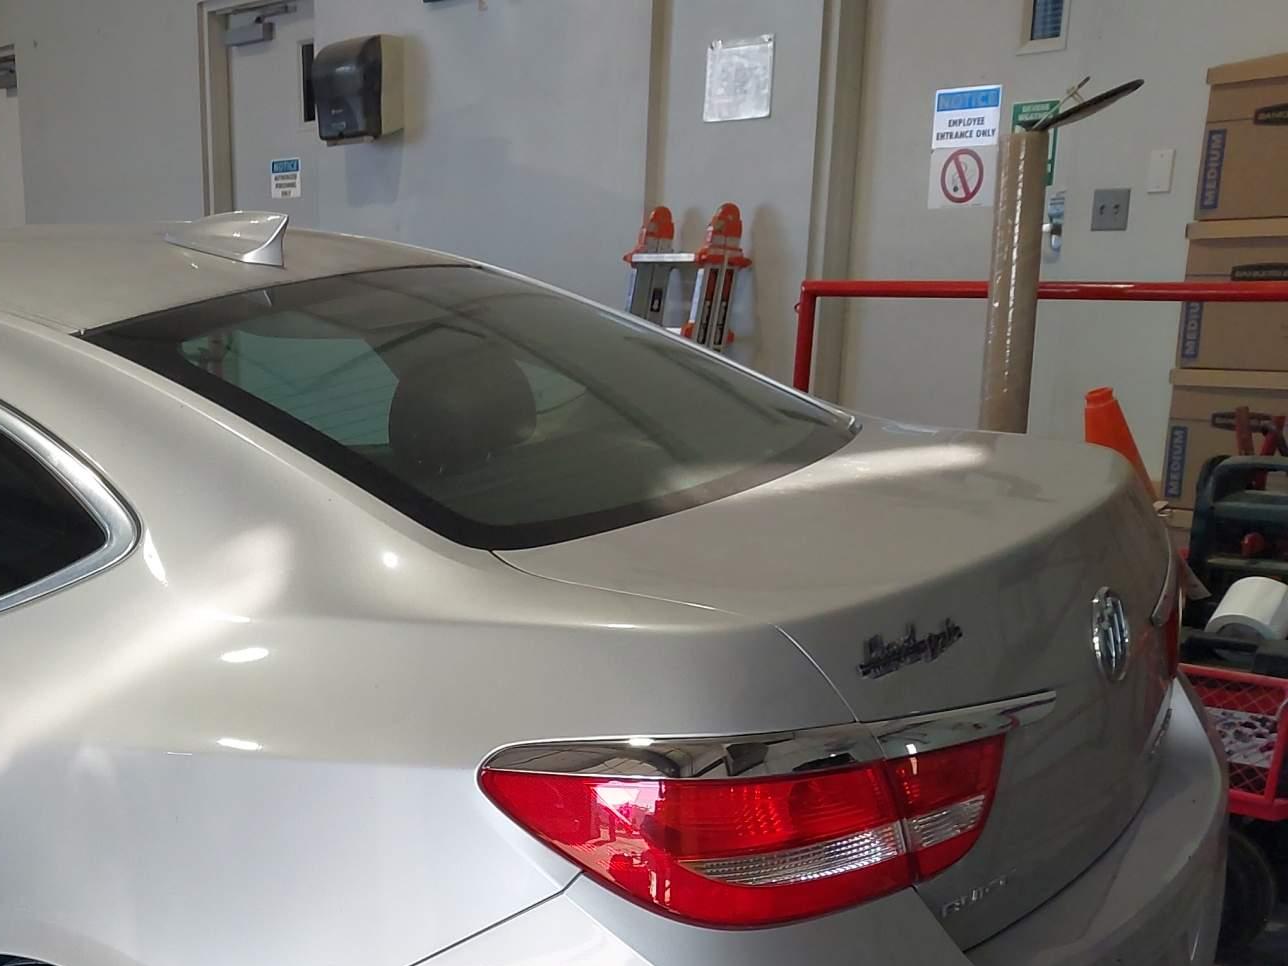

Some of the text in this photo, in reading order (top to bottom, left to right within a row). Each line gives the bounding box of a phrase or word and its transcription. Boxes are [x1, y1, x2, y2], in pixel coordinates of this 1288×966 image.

[936, 128, 997, 141] ENTRANCE ONLY
[948, 116, 985, 128] EMPLOYEE
[1202, 132, 1223, 207] MEDIUM
[1184, 302, 1200, 356] MEDIU
[1168, 429, 1185, 496] MEDIUM
